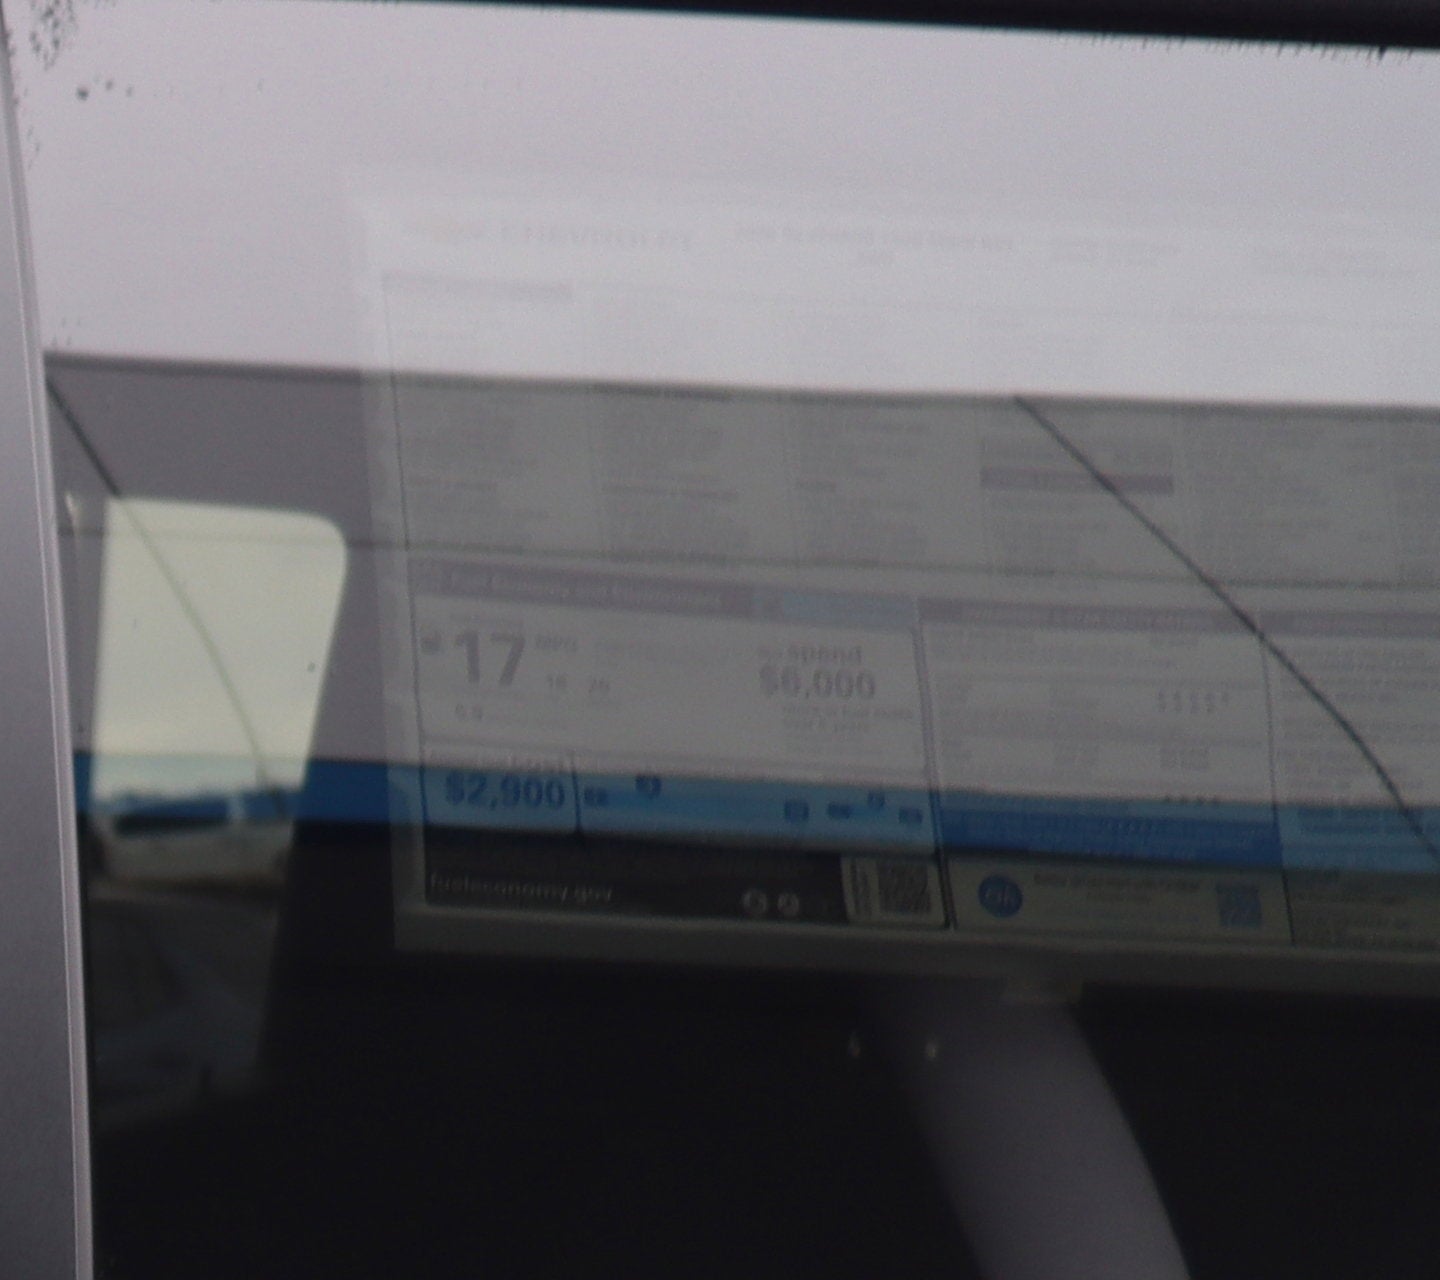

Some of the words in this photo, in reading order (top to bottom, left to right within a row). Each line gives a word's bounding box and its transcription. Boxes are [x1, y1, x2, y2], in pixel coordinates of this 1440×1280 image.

[453, 629, 526, 687] 17
[758, 663, 877, 701] $6,000
[444, 769, 566, 811] $2,900
